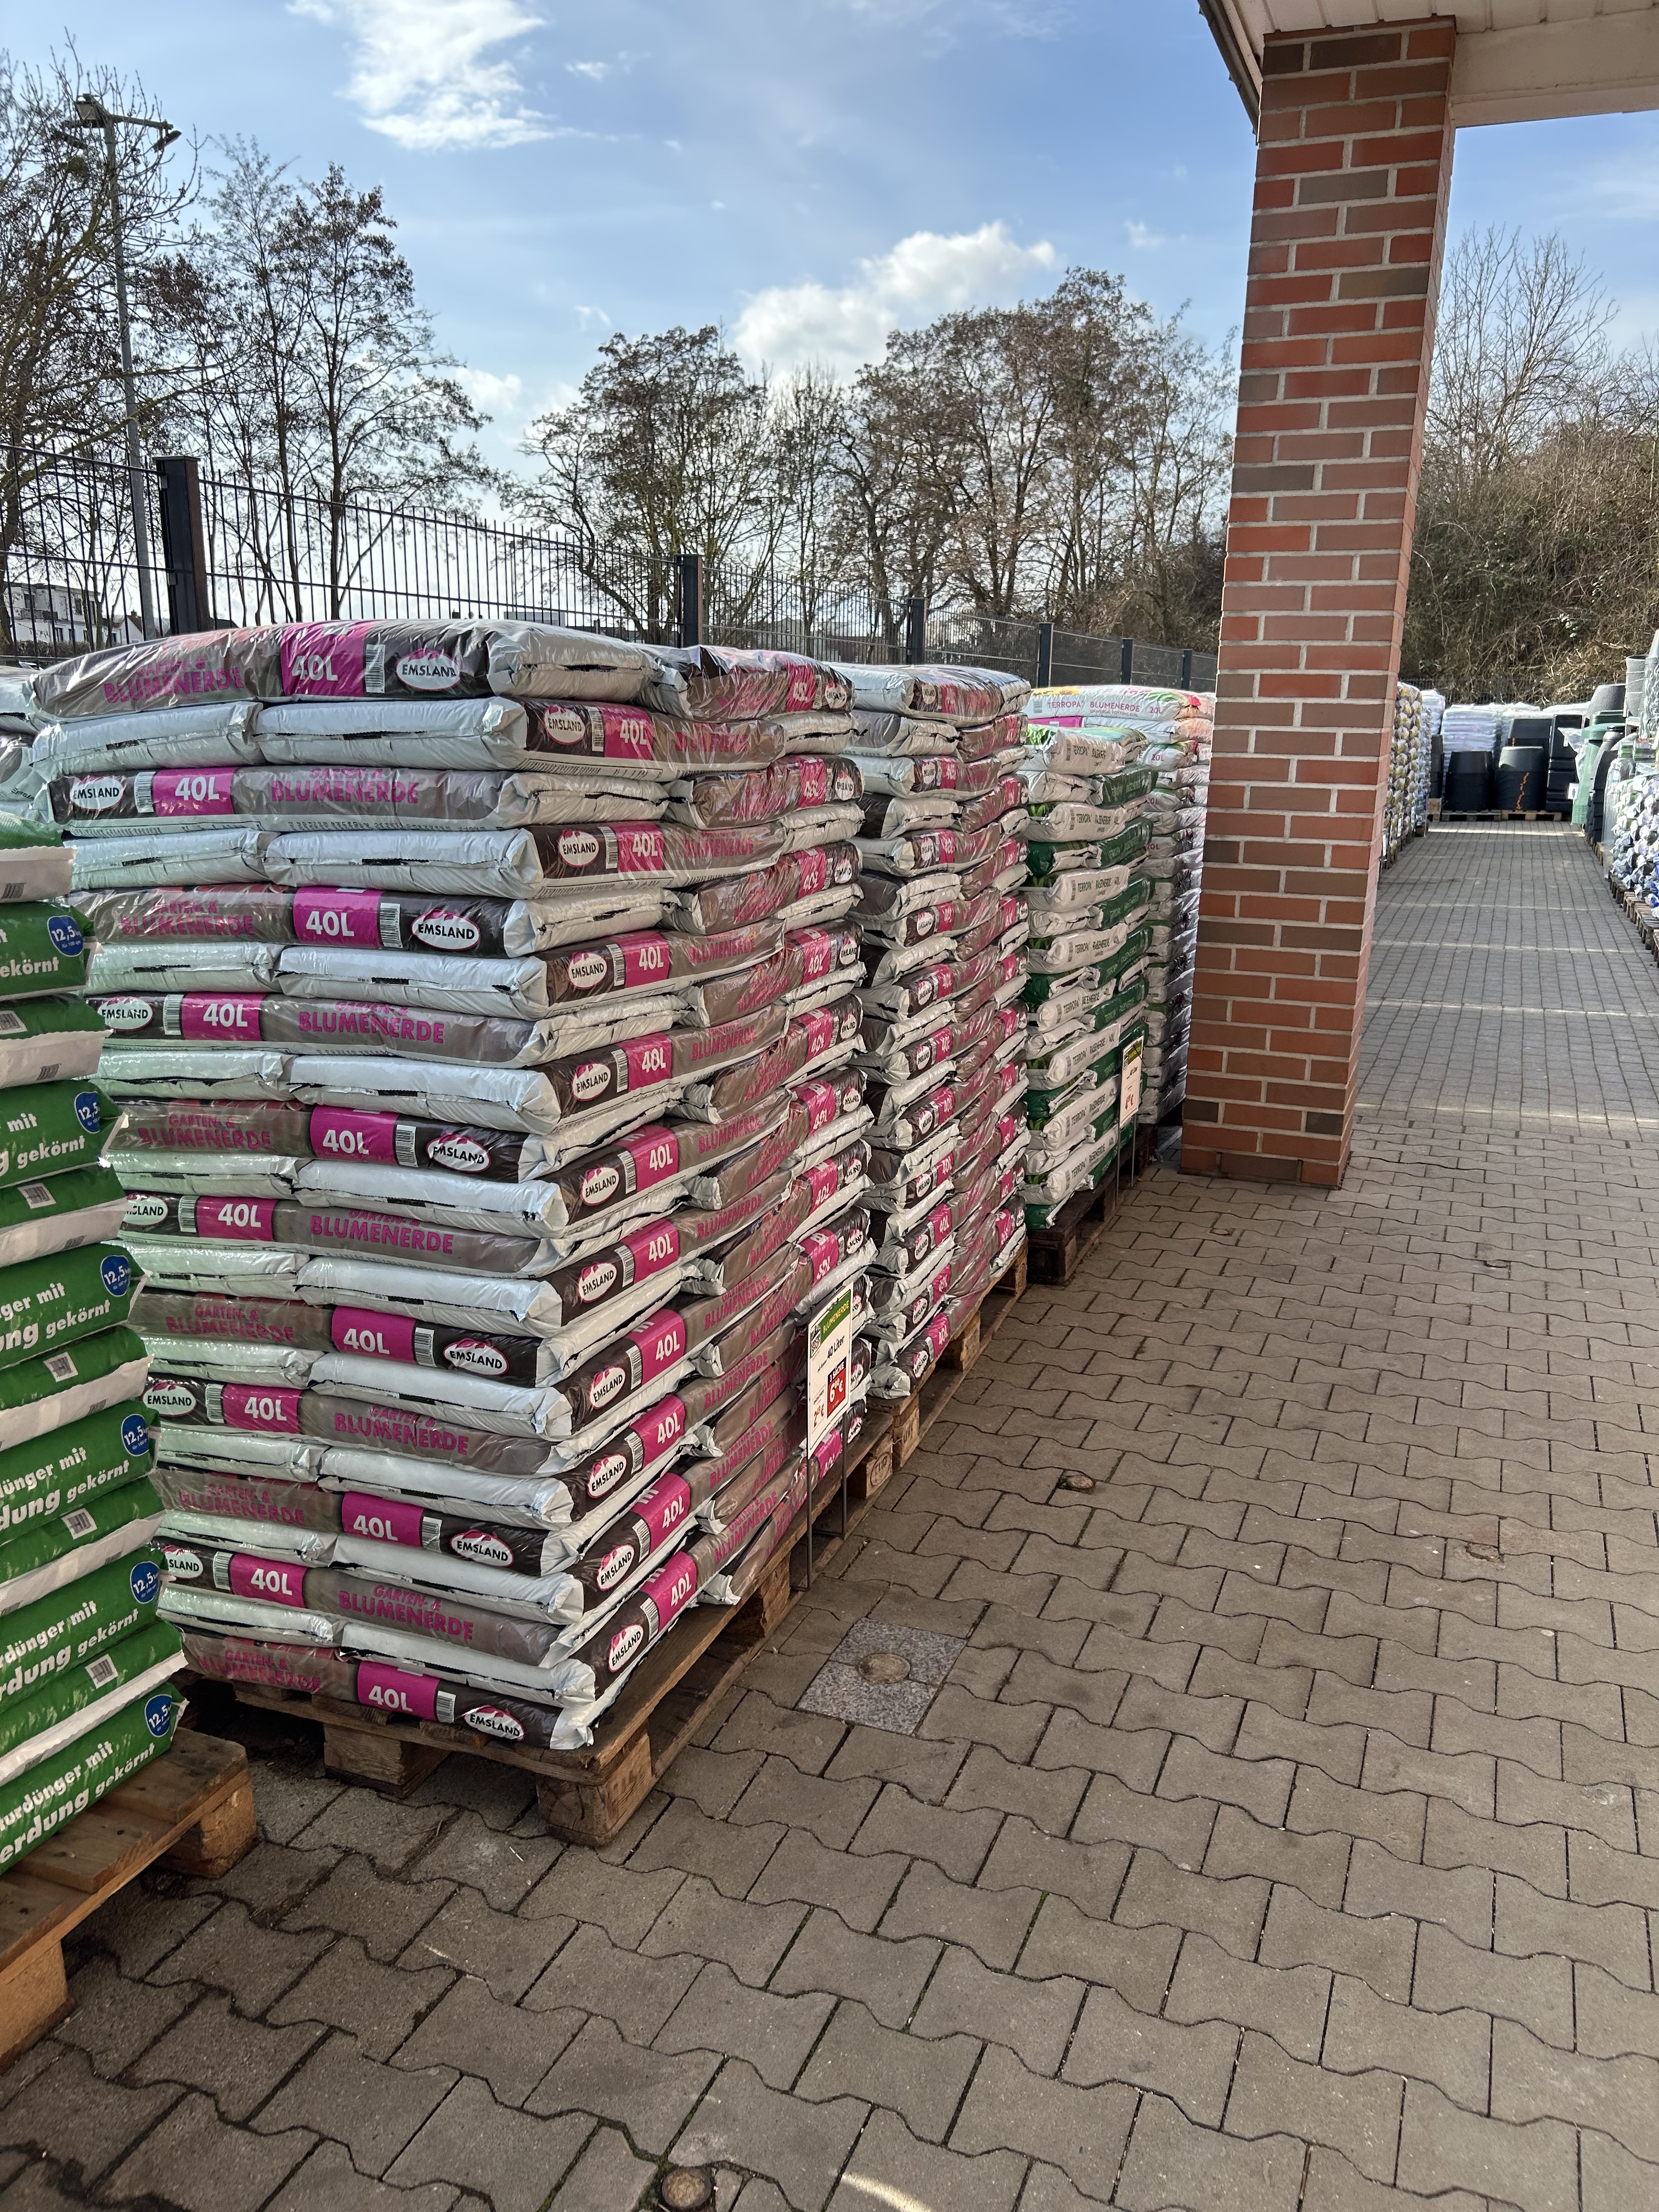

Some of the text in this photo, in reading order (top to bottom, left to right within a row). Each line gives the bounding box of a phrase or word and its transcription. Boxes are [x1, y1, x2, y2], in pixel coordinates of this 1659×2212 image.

[292, 654, 338, 681] 40L
[402, 663, 458, 678] EMSLAND
[104, 667, 245, 703] BLUMENERDE
[1090, 702, 1139, 712] BLUMENERDE
[548, 719, 583, 735] EMSLAND
[620, 722, 648, 746] 40L
[73, 786, 120, 800] EMSLAND
[174, 776, 219, 800] 40L
[272, 780, 419, 804] BLUMENERDE
[562, 842, 596, 854] EMSLAND
[633, 833, 658, 857] 40L
[121, 916, 255, 935] BLUMENERDE
[307, 910, 354, 937] 40L
[418, 923, 475, 940] EMSLAND
[639, 947, 664, 970] 40L
[689, 936, 755, 963] BLUMENERDE
[0, 957, 59, 978] ekörnt
[571, 962, 605, 979] EMSLAND
[102, 1008, 149, 1019] EMSLAND
[203, 1003, 247, 1027] 40L
[299, 1012, 444, 1043] BLUMENERDE
[692, 1025, 757, 1061] BLUMENERDE
[642, 1050, 667, 1073] 40L
[576, 1073, 608, 1093] EMSLAND
[7, 1113, 37, 1132] mit
[138, 1128, 271, 1148] BLUMENERDE
[322, 1130, 369, 1155] 40L
[698, 1120, 763, 1153] BLUMENERDE
[17, 1135, 85, 1169] gekörnt
[433, 1147, 484, 1165] EMSLAND
[648, 1146, 674, 1171] 40L
[585, 1175, 617, 1196] EMSLAND
[126, 1206, 163, 1216] SLAND
[218, 1204, 261, 1228] 40L
[697, 1193, 763, 1238] BLUMENERDE
[310, 1215, 454, 1254] BLUMENERDE
[648, 1237, 674, 1263] 40L
[582, 1270, 614, 1294] EMSLAND
[0, 1283, 65, 1321] ger mit
[195, 1304, 258, 1321] GARTEN- &
[704, 1276, 769, 1330] BLUMENERDE
[46, 1300, 110, 1339] gekörnt
[166, 1317, 294, 1341] BLUMENERDE
[823, 1300, 849, 1334] BLUMENERDE
[343, 1328, 390, 1355] 40L
[655, 1330, 681, 1361] 40L
[449, 1350, 503, 1370] EMSLAND
[594, 1373, 623, 1402] EMSLAND
[703, 1350, 768, 1411] BLUMENERDE
[147, 1396, 192, 1407] EMSLAND
[244, 1397, 287, 1421] 40L
[335, 1413, 469, 1455] BLUMENERDE
[657, 1413, 681, 1443] 40L
[59, 1447, 87, 1470] mit
[710, 1421, 773, 1489] BLUMENERDE
[591, 1462, 624, 1492] EMSLAND
[0, 1460, 129, 1531] dung gekörnt
[179, 1491, 304, 1525] BLUMENERDE
[662, 1495, 685, 1528] 40L
[353, 1515, 398, 1541] 40L
[715, 1492, 777, 1565] BLUMENERDE
[456, 1541, 509, 1562] EMSLAND
[169, 1559, 199, 1572] SLAND
[601, 1550, 632, 1585] EMSLAND
[251, 1568, 292, 1596] 40L
[670, 1572, 692, 1606] 40L
[70, 1600, 97, 1626] mit
[339, 1591, 473, 1640] BLUMENERDE
[0, 1608, 138, 1701] rdung gekörnt
[224, 1650, 274, 1667] GARTEN-
[612, 1631, 641, 1666] EMSLAND
[199, 1655, 321, 1694] BLUMENERDE
[368, 1686, 413, 1712] 40L
[469, 1714, 521, 1737] EMSLAND
[85, 1741, 113, 1769] mit
[0, 1742, 155, 1864] erdung gekörnt
